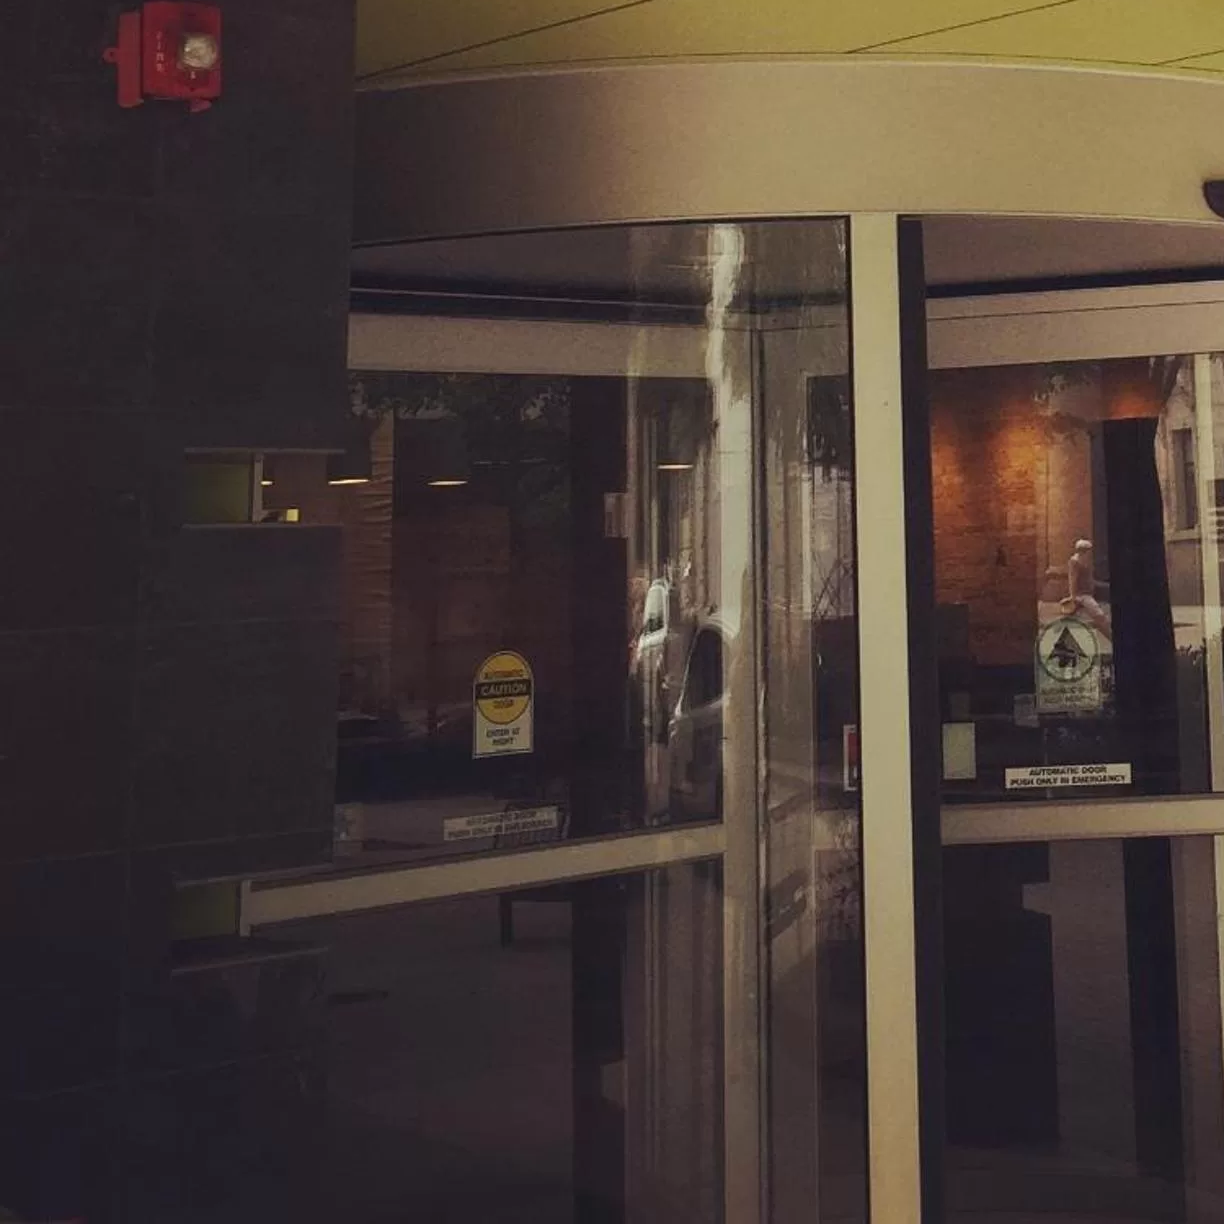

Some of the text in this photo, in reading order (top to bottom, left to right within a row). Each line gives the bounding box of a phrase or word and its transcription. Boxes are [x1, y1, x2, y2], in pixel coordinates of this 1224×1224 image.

[481, 683, 528, 696] CAUTION
[1029, 765, 1108, 777] AUTOMATIC DOOR
